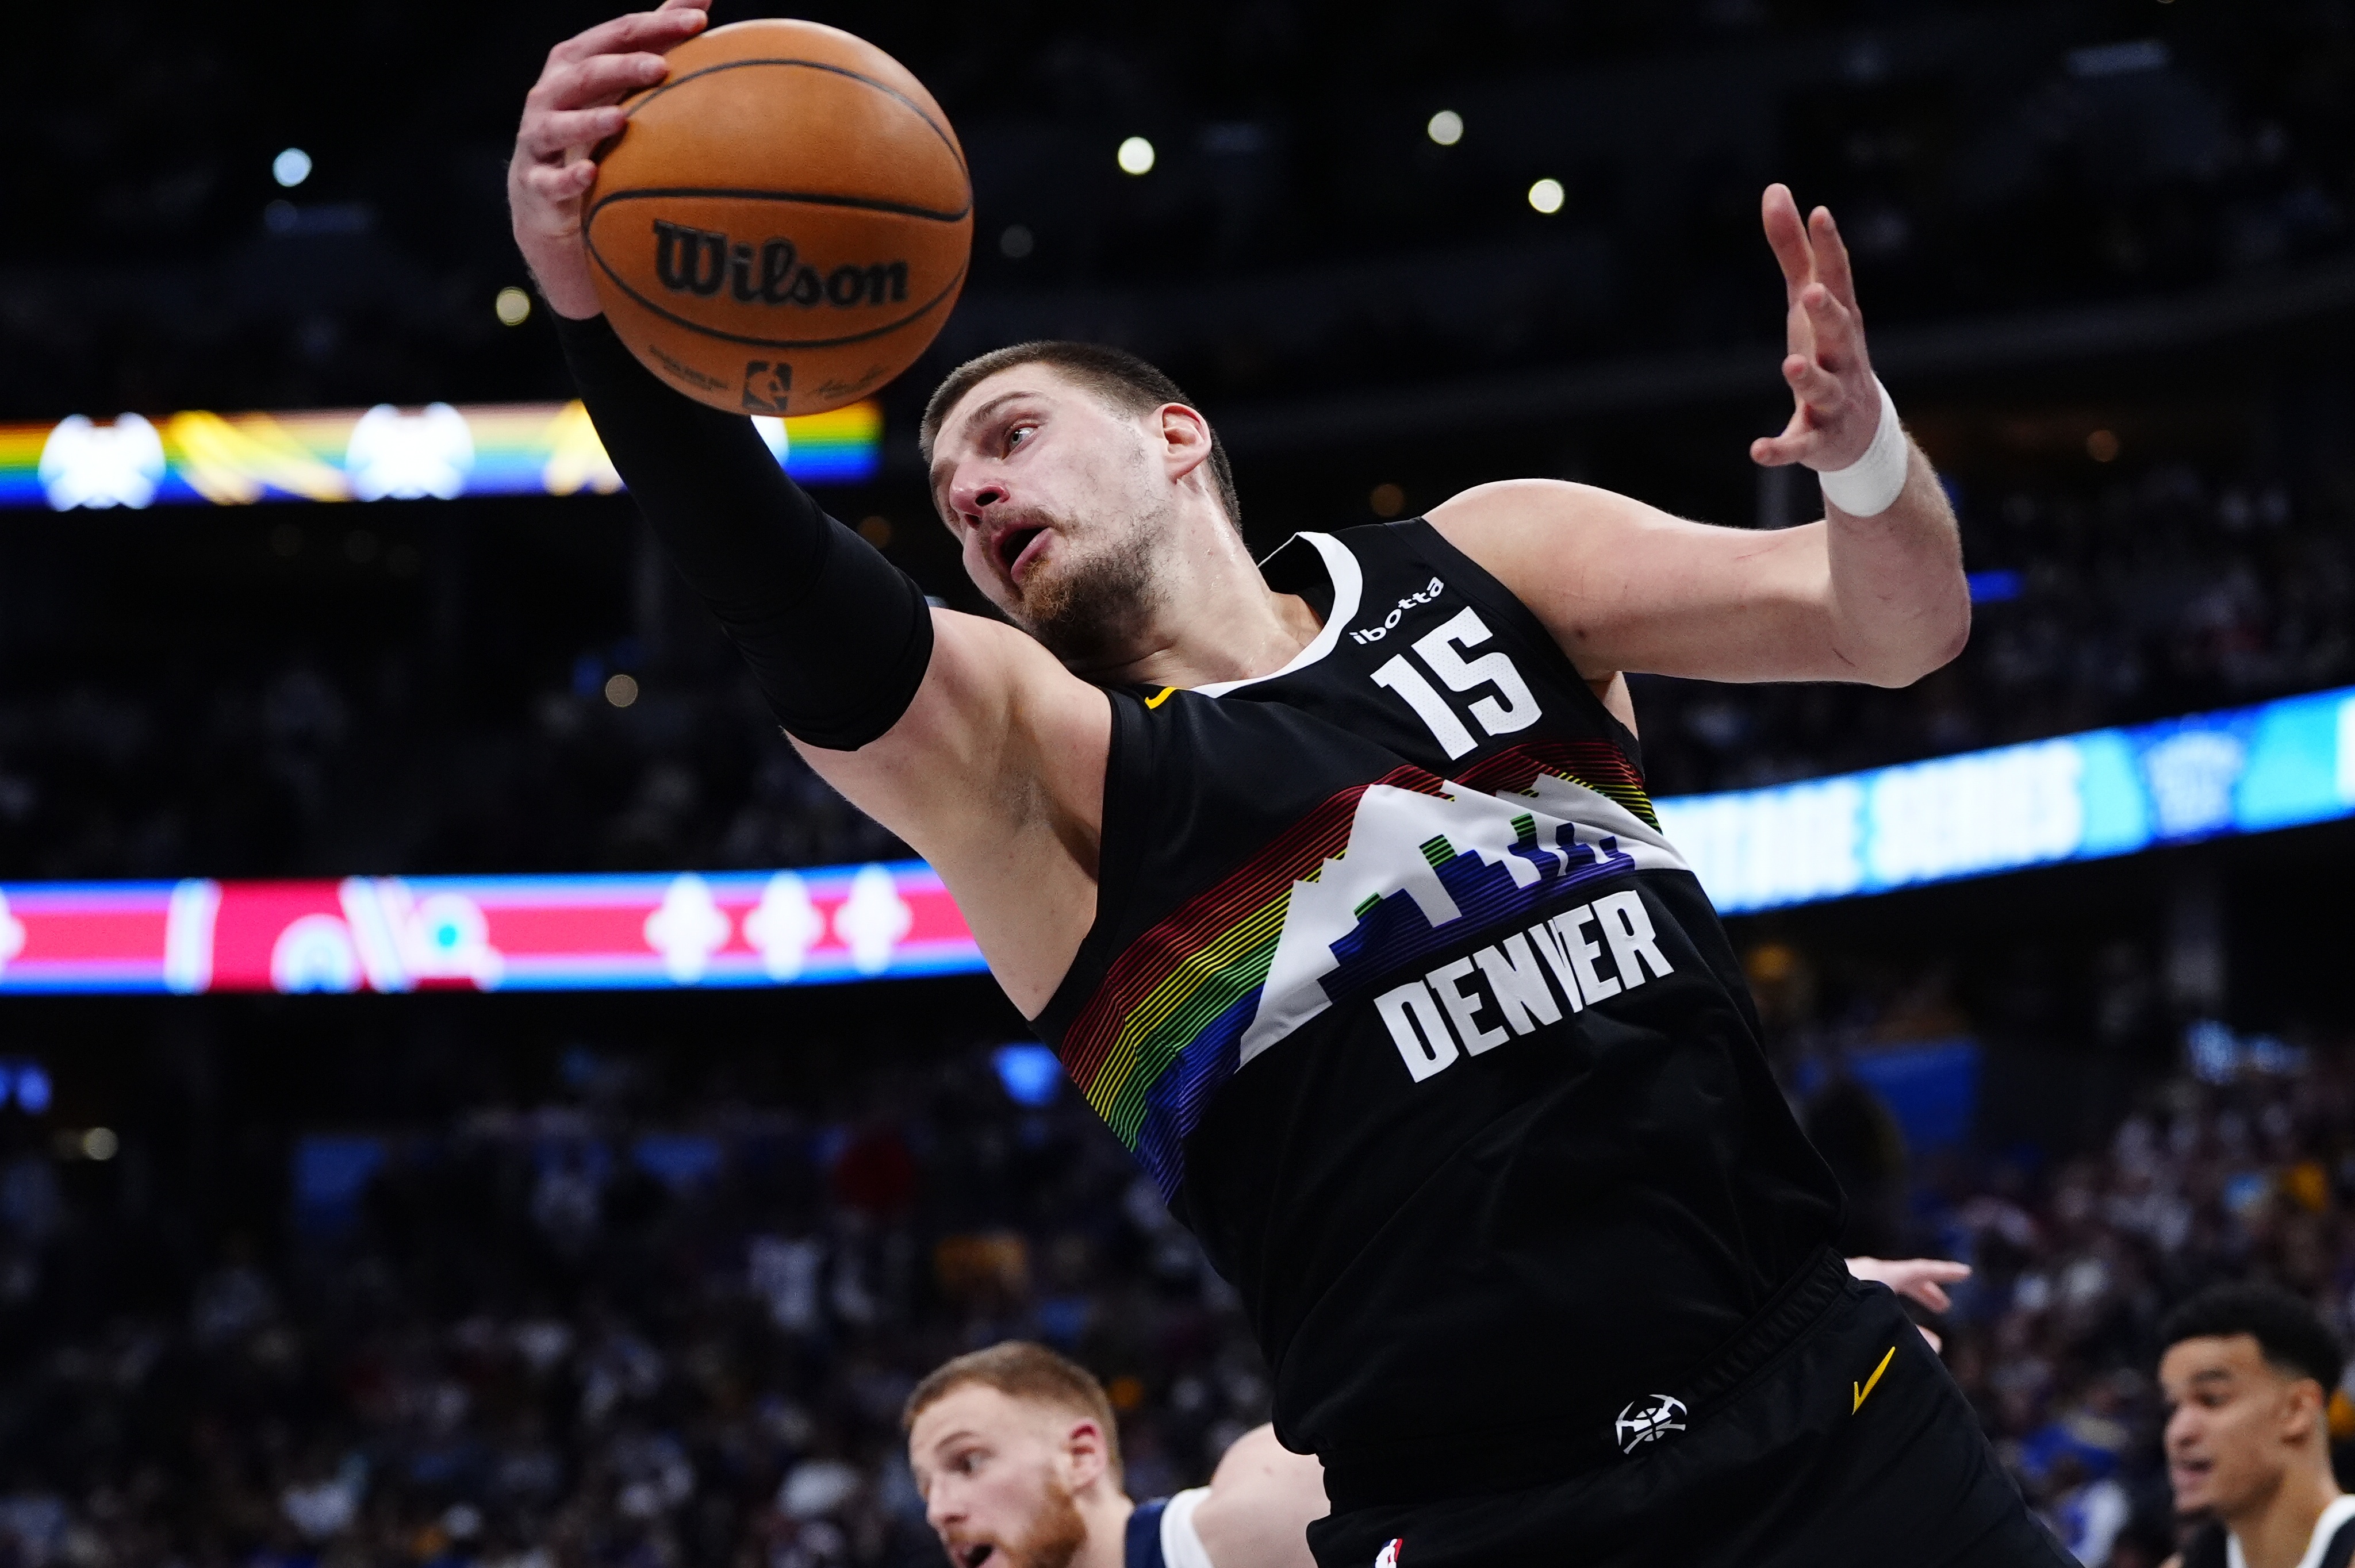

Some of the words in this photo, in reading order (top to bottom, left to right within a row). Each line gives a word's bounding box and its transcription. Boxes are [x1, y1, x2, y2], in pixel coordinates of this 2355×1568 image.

[653, 219, 908, 308] Wilson
[1349, 577, 1444, 645] ibotta
[1370, 606, 1543, 760] 15
[1374, 890, 1674, 1083] DENVER
